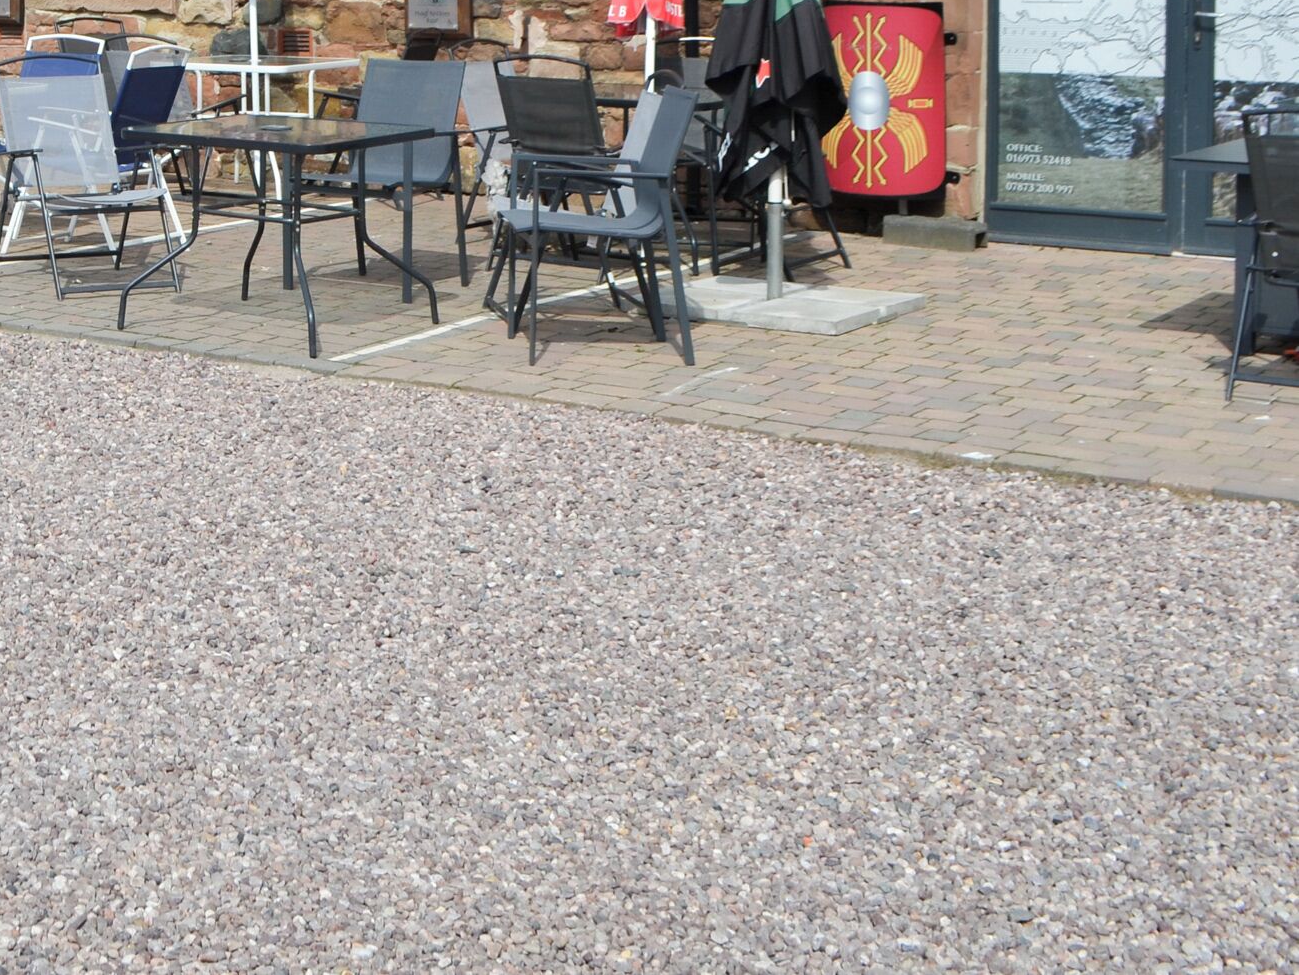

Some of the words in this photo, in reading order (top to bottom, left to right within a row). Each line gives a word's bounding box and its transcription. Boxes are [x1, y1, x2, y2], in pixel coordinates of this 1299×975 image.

[1005, 143, 1043, 153] OFFICE:
[1005, 153, 1041, 164] 016973
[1042, 154, 1072, 166] 52418
[1005, 172, 1045, 181] MOBILE:
[1036, 183, 1055, 194] 200
[1055, 184, 1075, 195] 997
